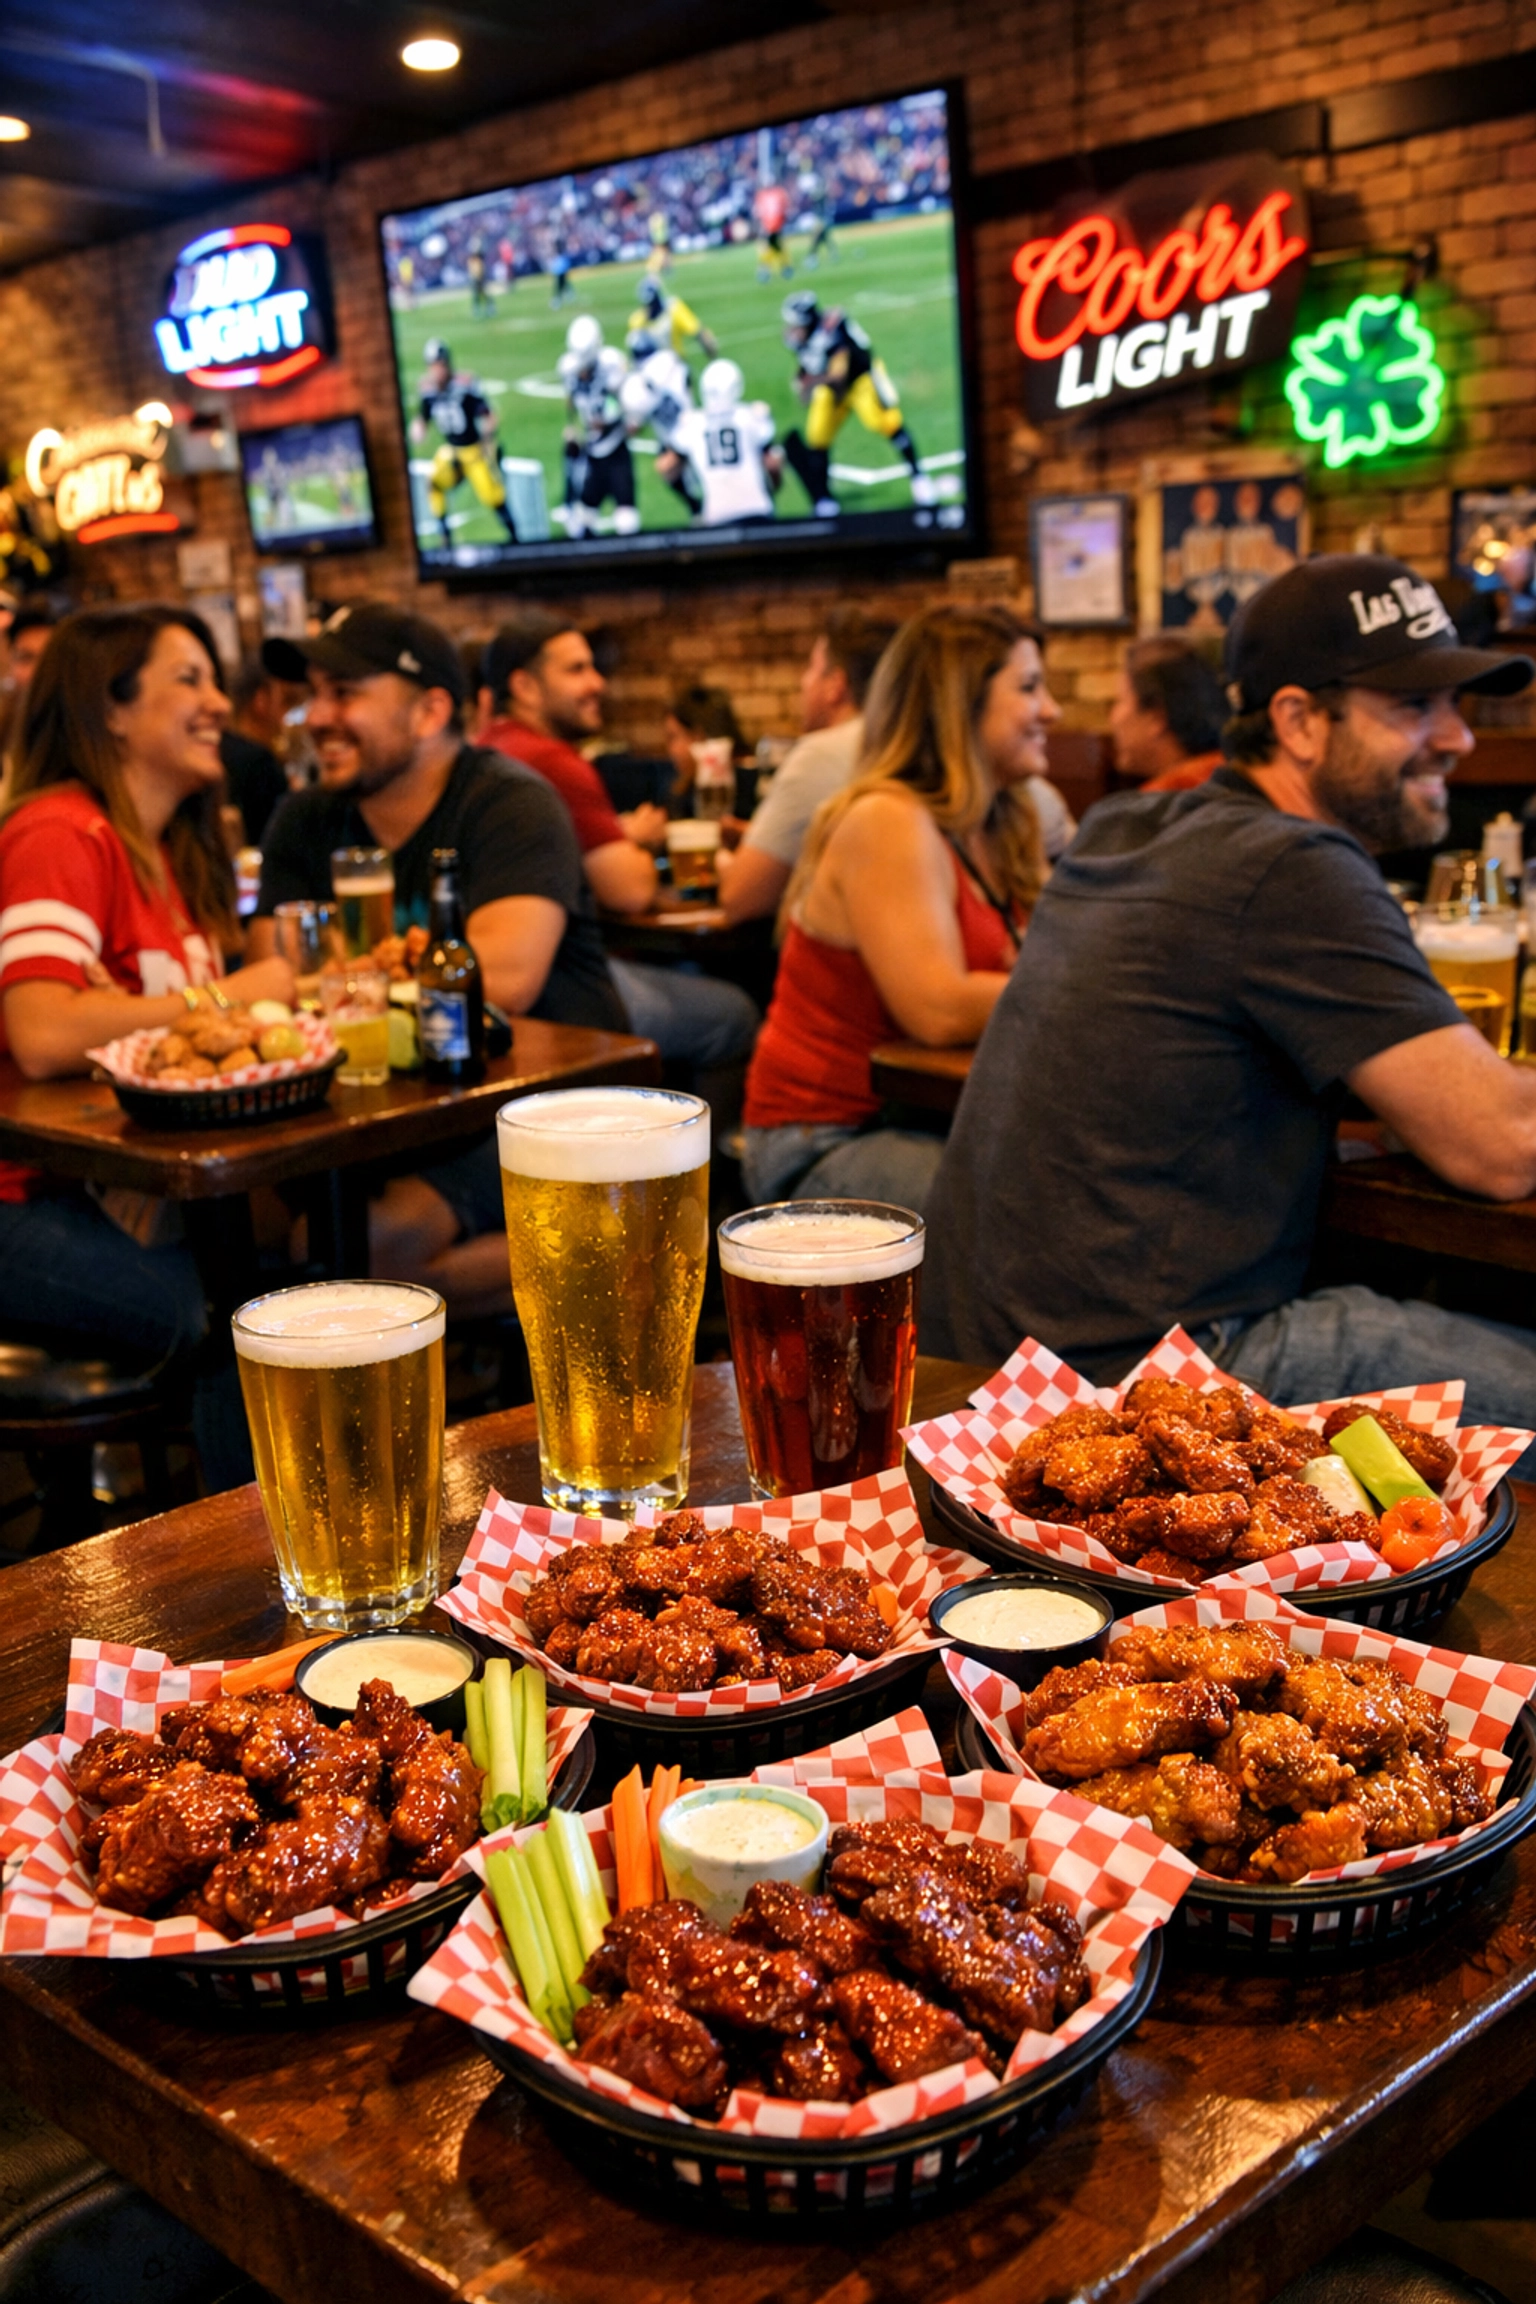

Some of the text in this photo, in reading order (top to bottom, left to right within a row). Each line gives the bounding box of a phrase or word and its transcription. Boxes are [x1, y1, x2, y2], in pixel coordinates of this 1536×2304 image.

[1012, 190, 1306, 360] Coors
[154, 289, 309, 374] LIGHT
[1056, 288, 1271, 409] LIGHT
[704, 428, 739, 466] 19
